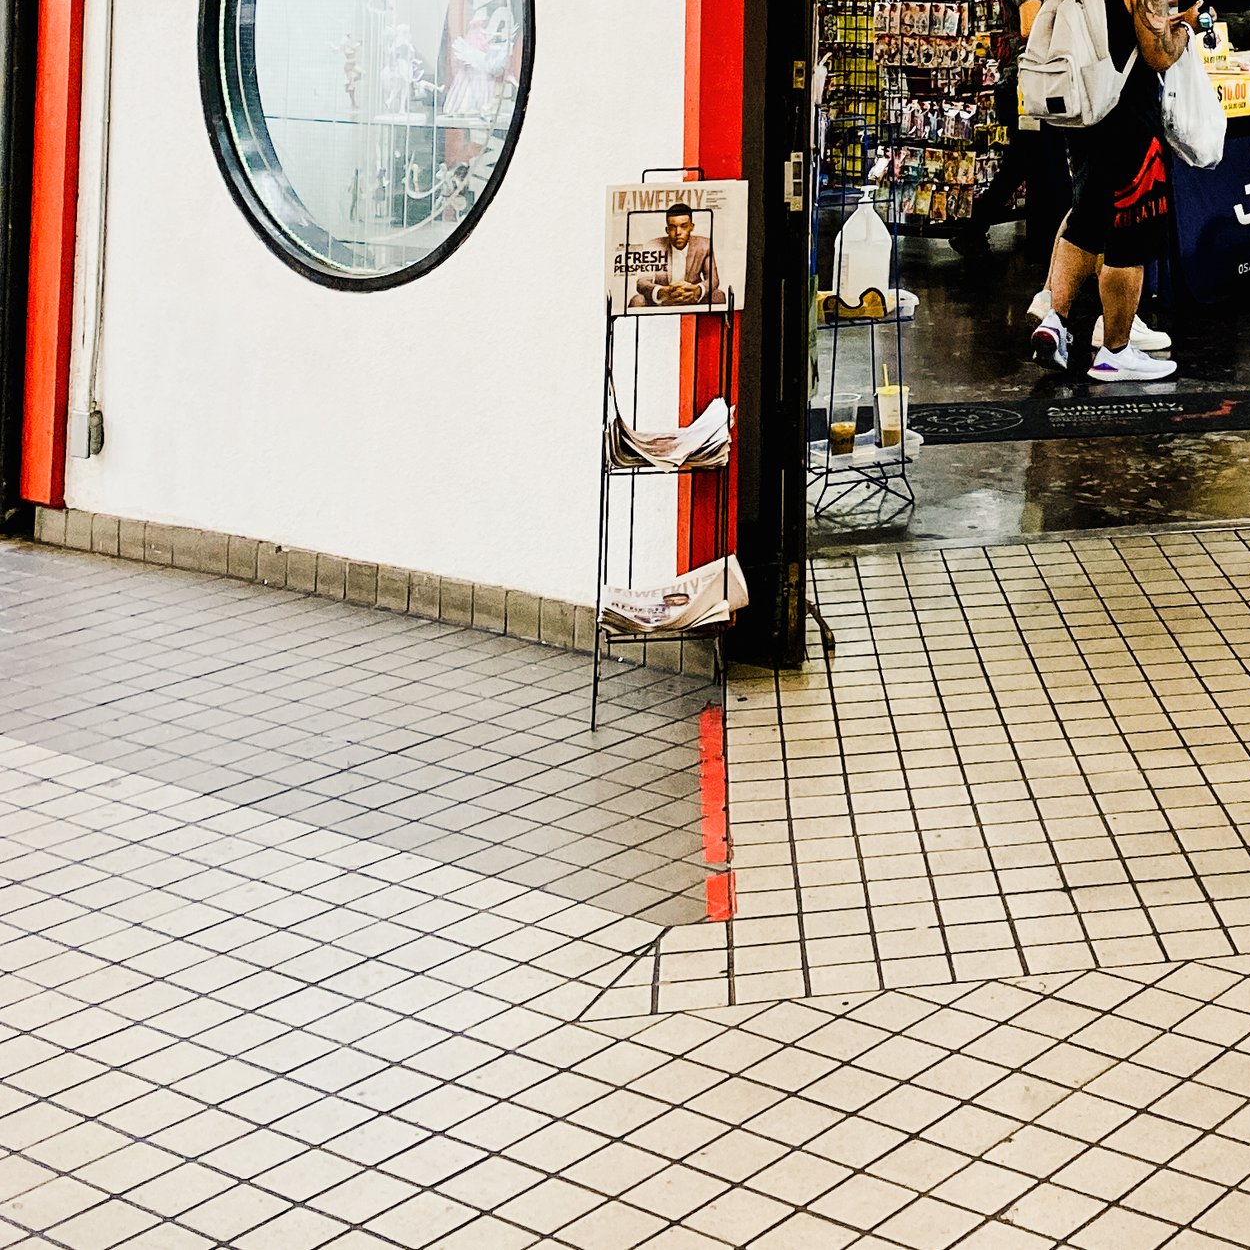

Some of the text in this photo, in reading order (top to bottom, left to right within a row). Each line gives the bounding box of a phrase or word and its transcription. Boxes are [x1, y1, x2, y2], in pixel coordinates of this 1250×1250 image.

[615, 250, 668, 265] A FRESH
[614, 264, 668, 273] PERSPECTIVE
